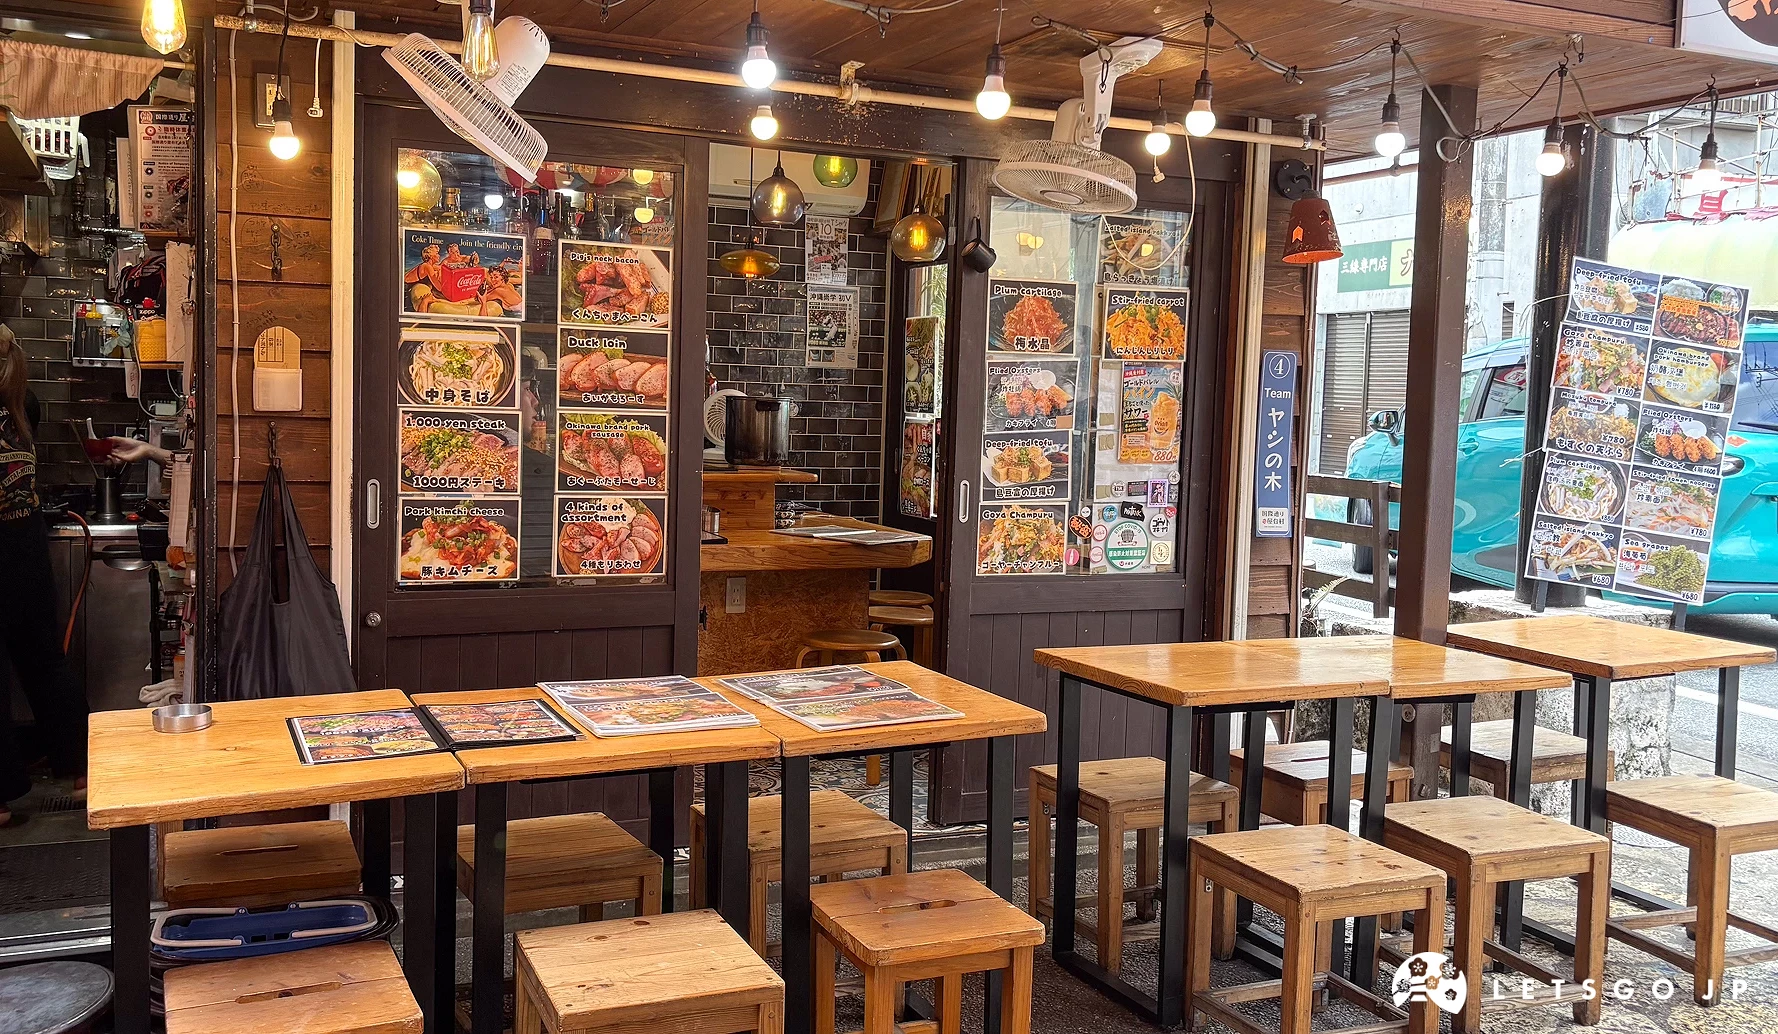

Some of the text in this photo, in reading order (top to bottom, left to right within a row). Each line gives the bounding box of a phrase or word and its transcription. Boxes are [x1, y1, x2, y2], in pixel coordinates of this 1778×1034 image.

[1130, 225, 1151, 235] island
[411, 235, 427, 244] Coke
[428, 235, 444, 245] Time
[459, 238, 473, 247] Join
[474, 240, 485, 248] the
[486, 241, 511, 251] friendly
[615, 256, 640, 264] bacon
[1576, 266, 1643, 286] Deep-fried tofu
[994, 285, 1062, 298] Plum cartilage
[1111, 295, 1185, 307] Stir-fried carrot
[568, 336, 627, 349] Duck loin
[1587, 333, 1626, 345] Champuru
[1654, 353, 1670, 361] pork
[1688, 353, 1710, 361] brand
[425, 388, 491, 404] 中身そば
[1264, 387, 1292, 399] Team
[1617, 386, 1635, 397] ¥780
[443, 418, 468, 430] yen
[470, 419, 507, 430] steak
[565, 422, 651, 432] Okinawa brand pork
[591, 431, 625, 440] sausage
[985, 437, 1054, 449] Deep-fried tofu
[1556, 436, 1624, 458] もずくの天ぷら
[1264, 407, 1285, 492] ヤシの木
[412, 475, 506, 489] 1000円ステーキ
[404, 505, 505, 516] Pork kimchi cheese
[564, 501, 624, 512] 4 kinds of
[560, 513, 627, 523] assortment
[982, 510, 1054, 520] Goya Champuru
[1625, 538, 1639, 547] Sea
[580, 559, 642, 570] 4種もりあわせ
[981, 560, 1060, 570] ゴーヤーチャンプルー
[421, 565, 499, 578] 豚キムチーズ
